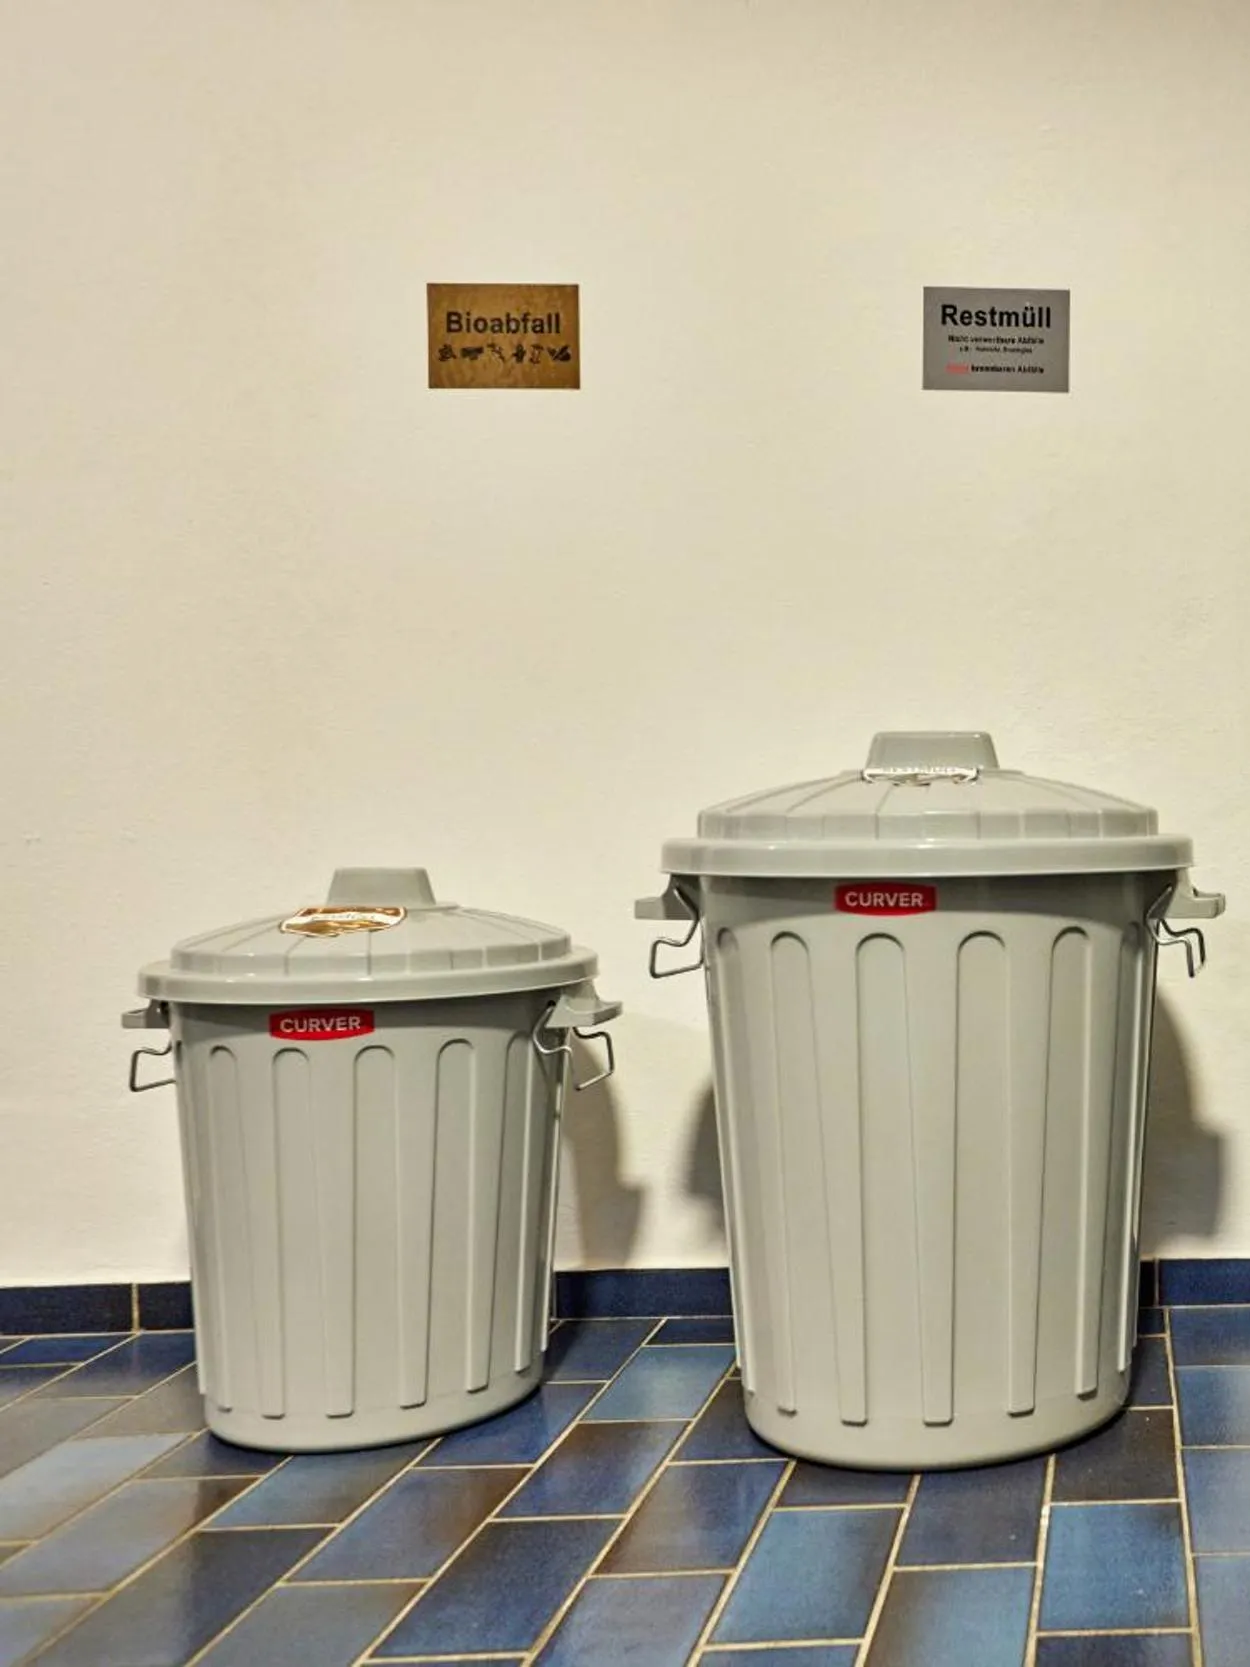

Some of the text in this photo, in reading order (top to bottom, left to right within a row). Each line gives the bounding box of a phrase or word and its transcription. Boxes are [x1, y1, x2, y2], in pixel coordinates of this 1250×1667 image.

[446, 311, 561, 334] Bioabfall
[941, 303, 1051, 328] Restmüll
[844, 891, 924, 908] CURVER
[280, 1016, 361, 1033] CURVER
